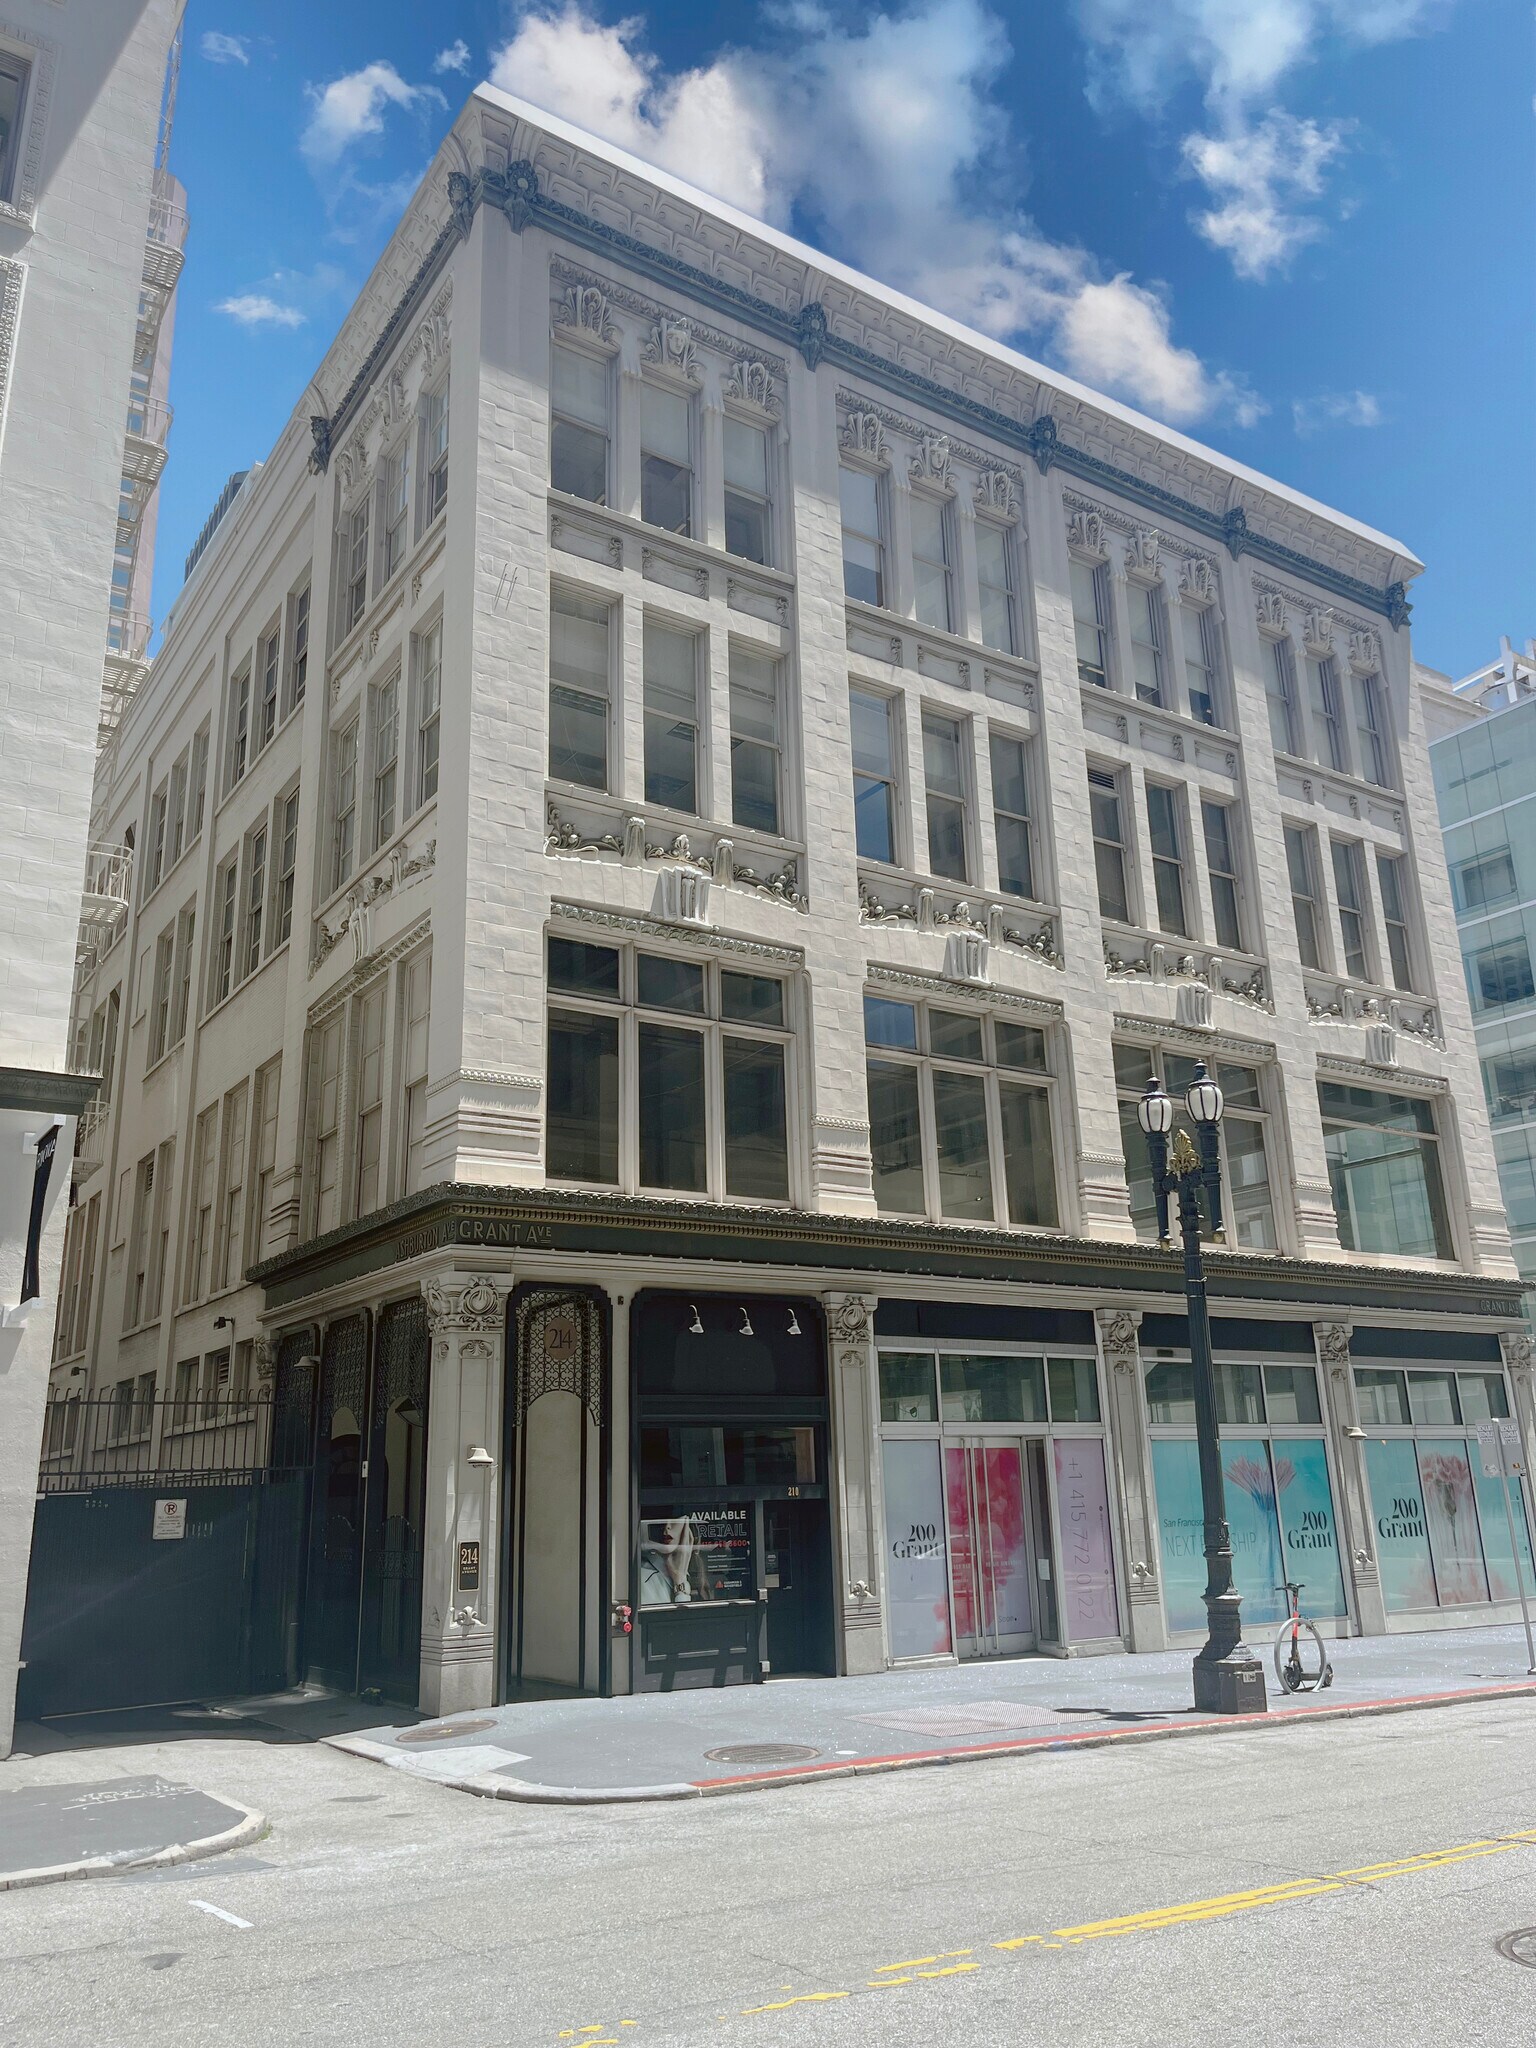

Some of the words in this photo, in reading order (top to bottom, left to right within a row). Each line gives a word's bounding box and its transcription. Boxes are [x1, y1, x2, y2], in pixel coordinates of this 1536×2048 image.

[460, 1221, 520, 1241] GRANT
[526, 1226, 552, 1243] AVE
[396, 1227, 439, 1259] ASHBURTON
[1481, 1300, 1506, 1312] GRANT
[549, 1328, 573, 1350] 214
[787, 1486, 799, 1497] 210
[690, 1511, 747, 1521] AVAILABLE
[1070, 1490, 1086, 1522] 415
[1392, 1498, 1418, 1519] 200
[697, 1523, 747, 1538] RETAIL
[1164, 1519, 1176, 1527] San
[1178, 1519, 1204, 1527] Francisc
[1302, 1511, 1327, 1531] 200
[1378, 1518, 1424, 1538] Grant
[908, 1524, 936, 1542] 200
[1287, 1530, 1333, 1549] Grant
[461, 1548, 478, 1564] 214
[892, 1541, 939, 1559] Grant
[1073, 1530, 1091, 1565] 772
[1166, 1535, 1196, 1557] NEXT
[1076, 1573, 1095, 1619] 0122
